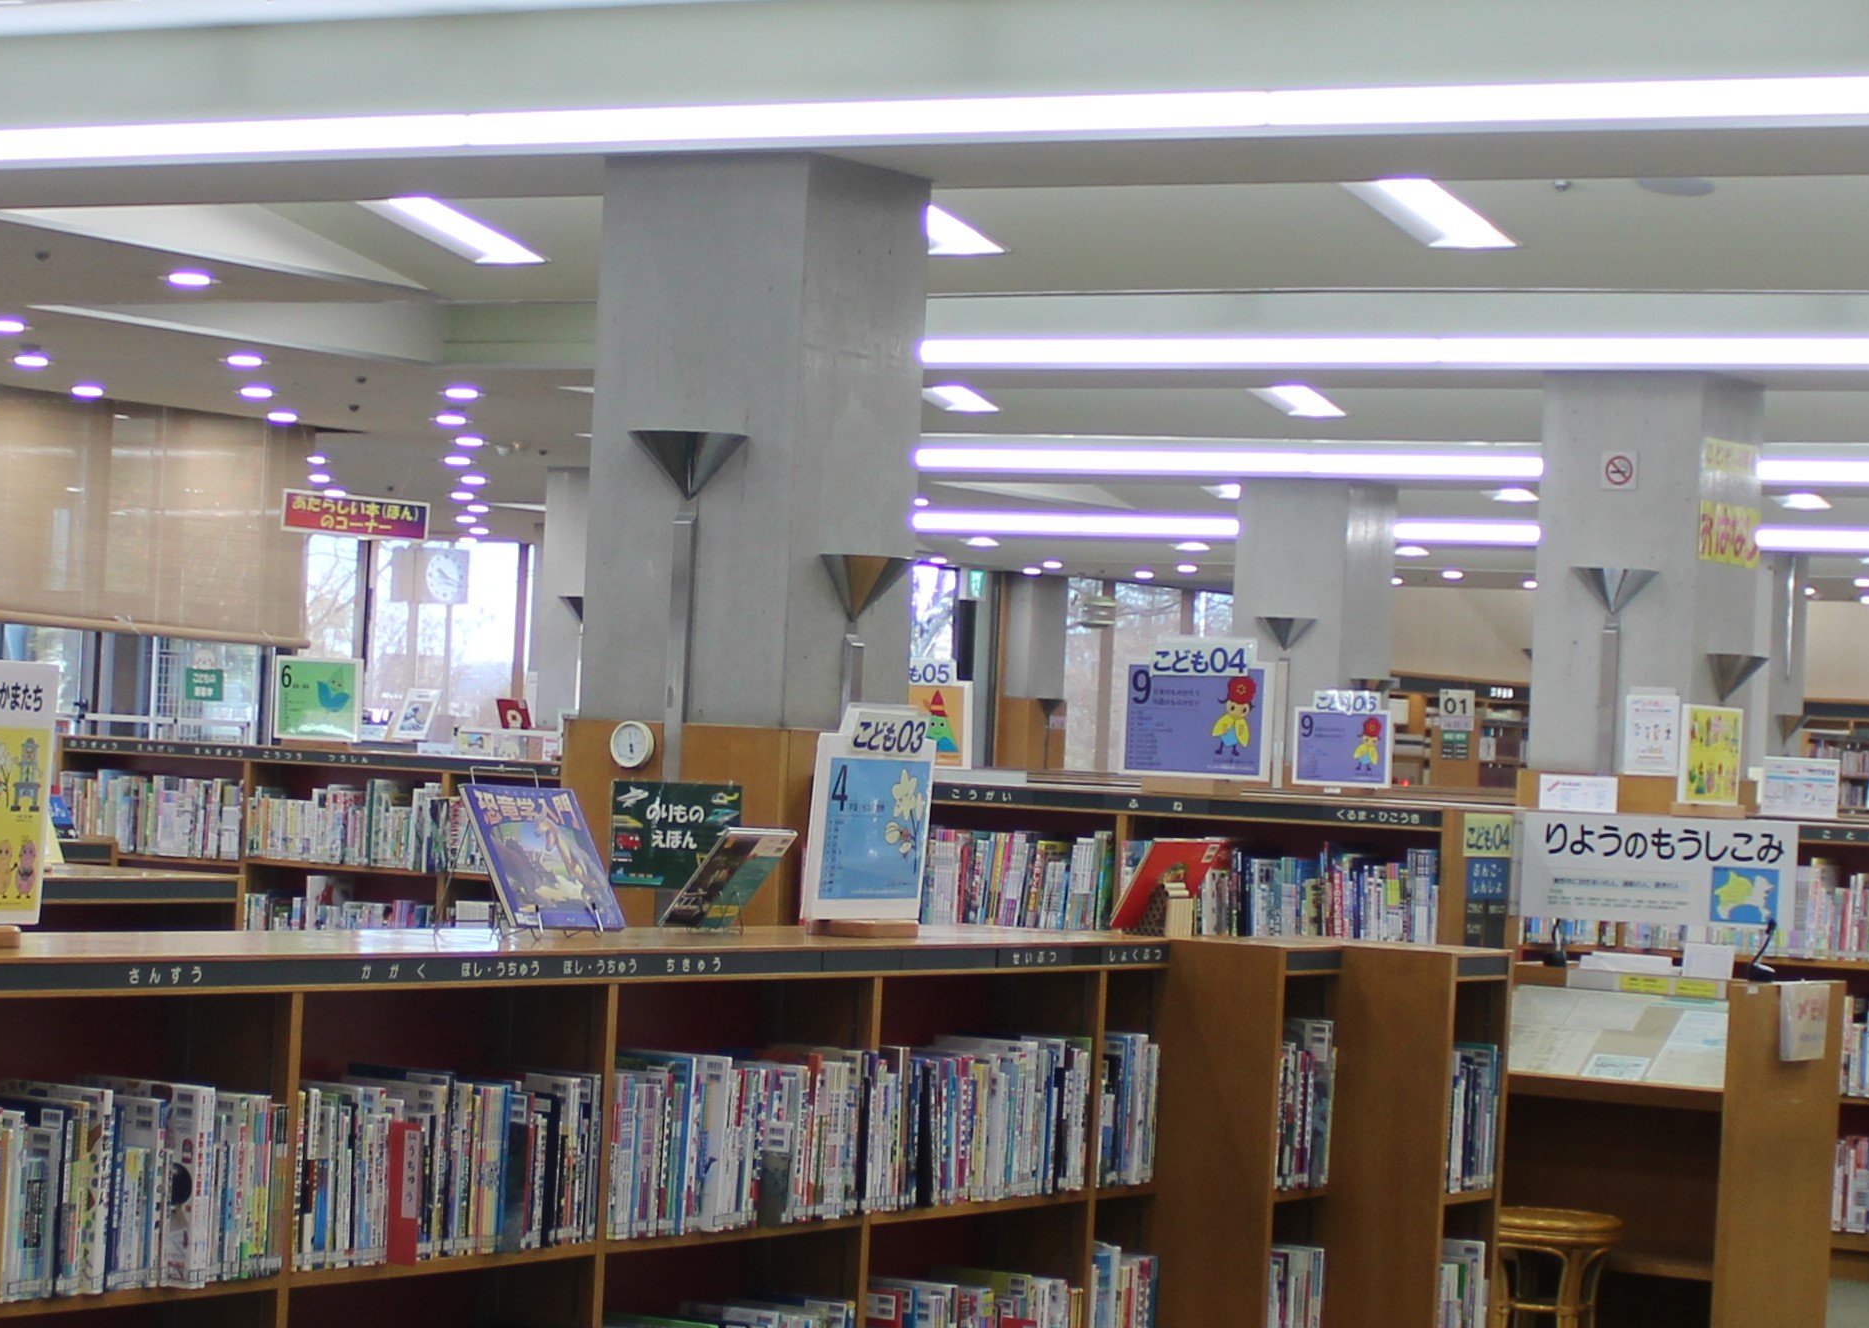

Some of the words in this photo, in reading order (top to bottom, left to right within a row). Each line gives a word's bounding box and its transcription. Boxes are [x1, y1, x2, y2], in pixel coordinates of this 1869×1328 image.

[319, 514, 393, 534] のコーナー
[1152, 647, 1248, 674] こども04
[281, 664, 292, 689] 6
[909, 663, 949, 684] も05
[1131, 669, 1152, 705] 9
[1444, 698, 1468, 715] 01
[853, 720, 927, 754] こども03
[1300, 715, 1313, 738] 9
[831, 764, 849, 812] 4
[951, 788, 1012, 802] こうがい
[473, 788, 581, 831] 恐竜学入門
[646, 802, 704, 824] のりもの
[1336, 810, 1421, 825] くるま・ひこうき
[651, 829, 698, 850] えほん
[1466, 824, 1511, 852] こども04
[1545, 822, 1785, 864] りようのもうしこみ
[665, 958, 723, 974] ちきゅう
[1012, 950, 1058, 965] せいぶつ
[1109, 948, 1163, 963] しょくぶつ
[128, 966, 204, 985] さんすう
[361, 963, 426, 980] かがく
[461, 962, 541, 979] ほし・うちゅう
[563, 959, 638, 976] ほし・うちゅう
[405, 1146, 418, 1205] うちゅう
